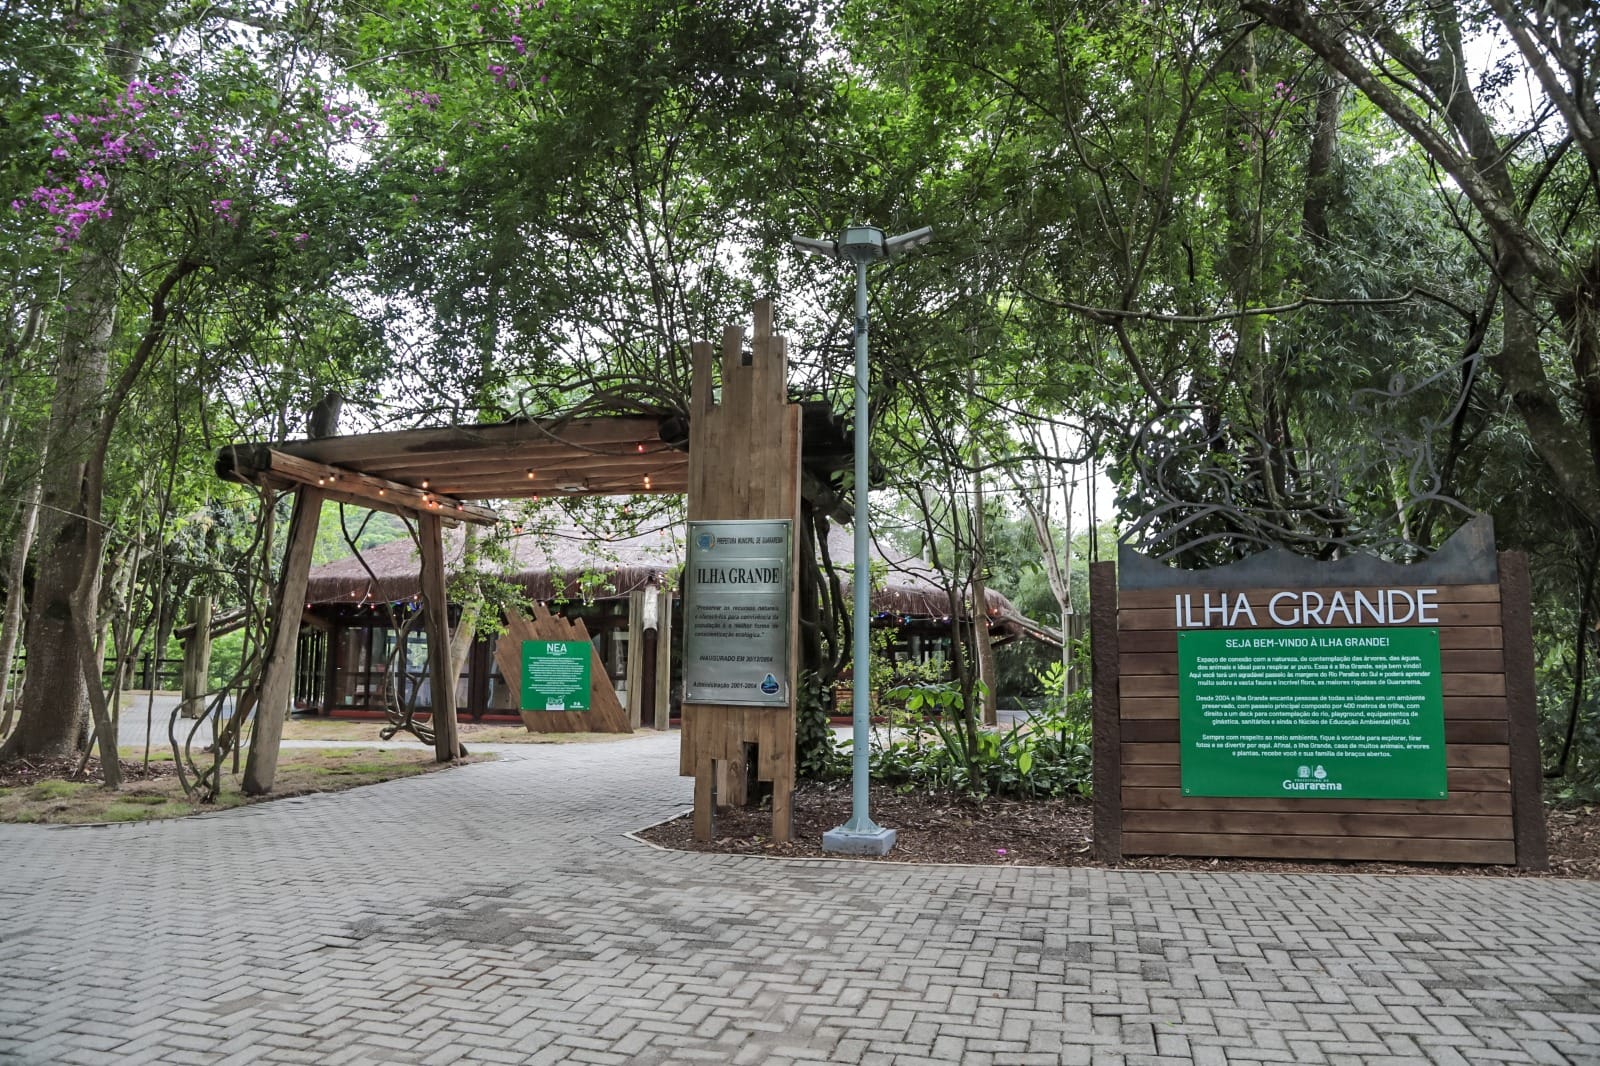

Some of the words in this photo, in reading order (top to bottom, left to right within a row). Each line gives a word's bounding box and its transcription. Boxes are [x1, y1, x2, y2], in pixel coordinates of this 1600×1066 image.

[698, 568, 726, 583] ILHA
[729, 568, 779, 583] GRANDE
[1175, 592, 1257, 628] ILHA
[1269, 589, 1439, 626] GRANDE
[1225, 639, 1251, 647] SEJA
[1254, 639, 1308, 647] BEM-VINDO
[1311, 636, 1317, 647] À
[1320, 638, 1342, 647] ILHA
[1345, 638, 1389, 647] GRANDE!
[546, 643, 567, 652] NEA
[1282, 779, 1342, 790] Guararema
